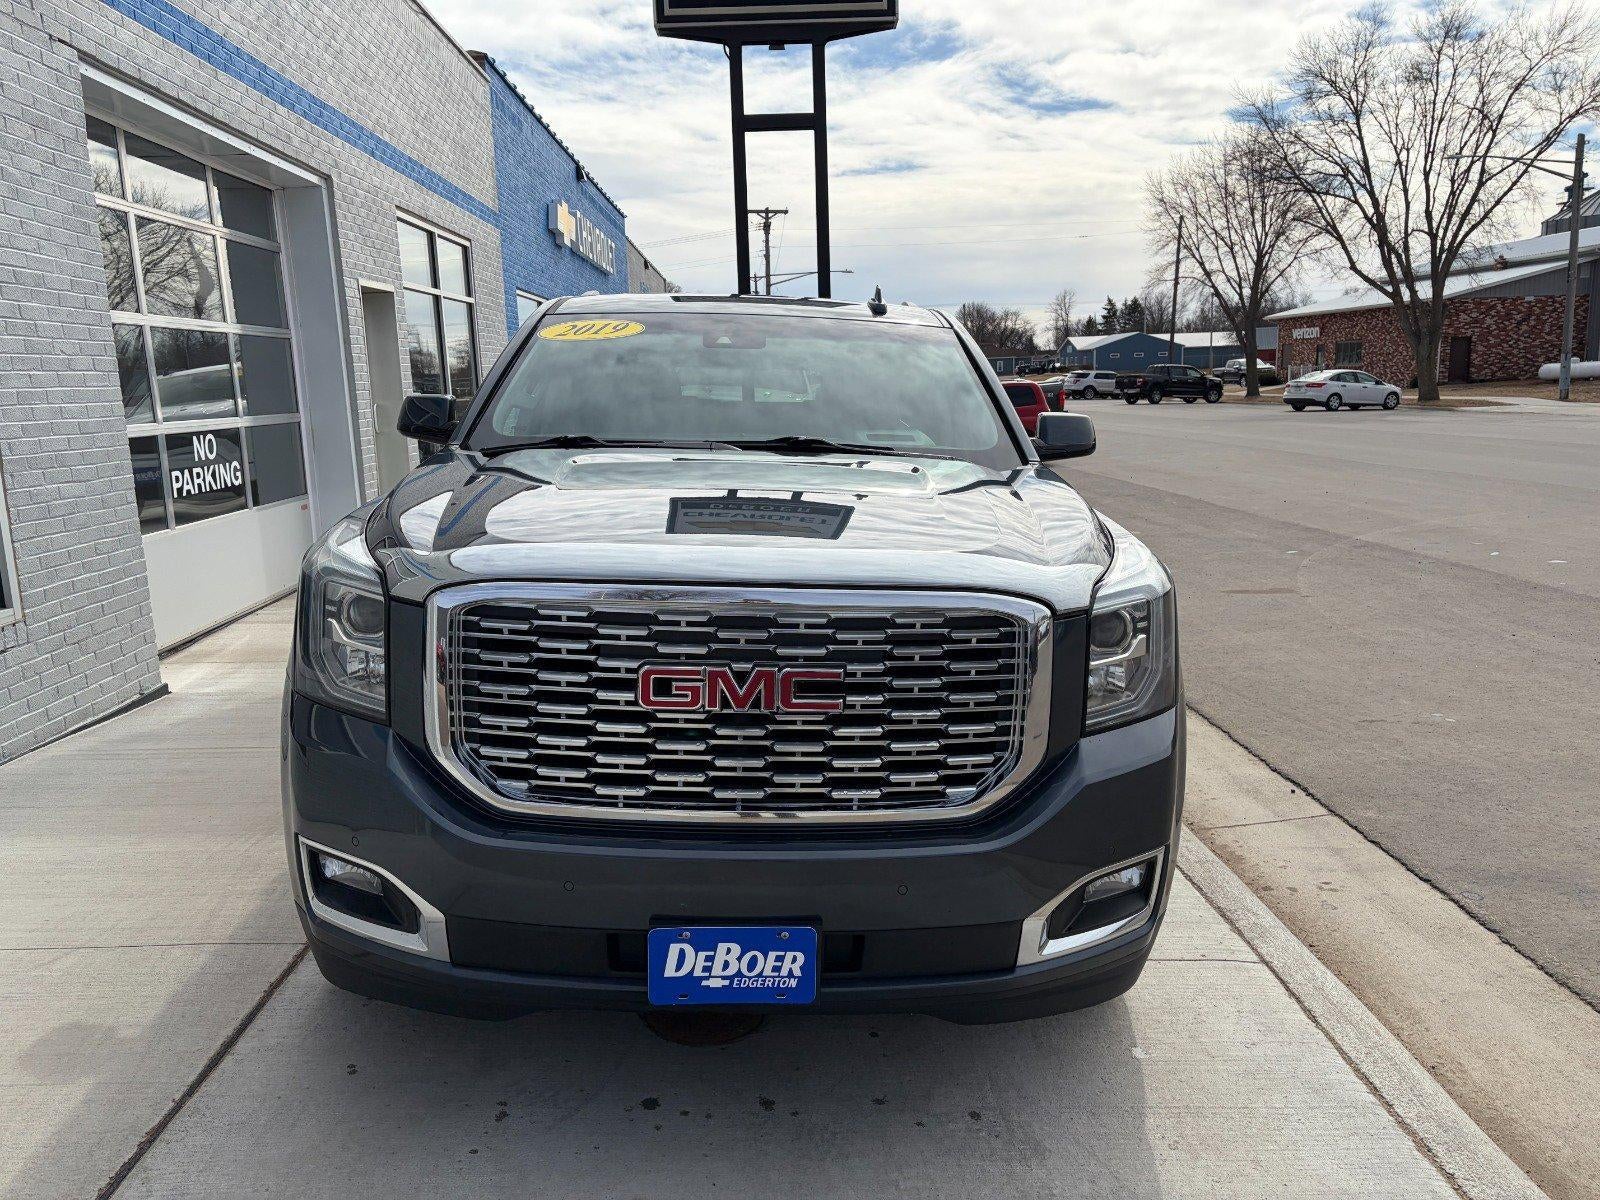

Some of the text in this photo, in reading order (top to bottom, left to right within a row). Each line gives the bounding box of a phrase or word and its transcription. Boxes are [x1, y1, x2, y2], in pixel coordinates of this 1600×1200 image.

[576, 209, 616, 275] CHEVROLET
[553, 322, 630, 337] 2019
[1292, 327, 1320, 339] verizon
[193, 433, 217, 461] NO
[171, 460, 242, 498] PARKING
[638, 664, 846, 712] GMC
[733, 977, 798, 988] EDGERTON
